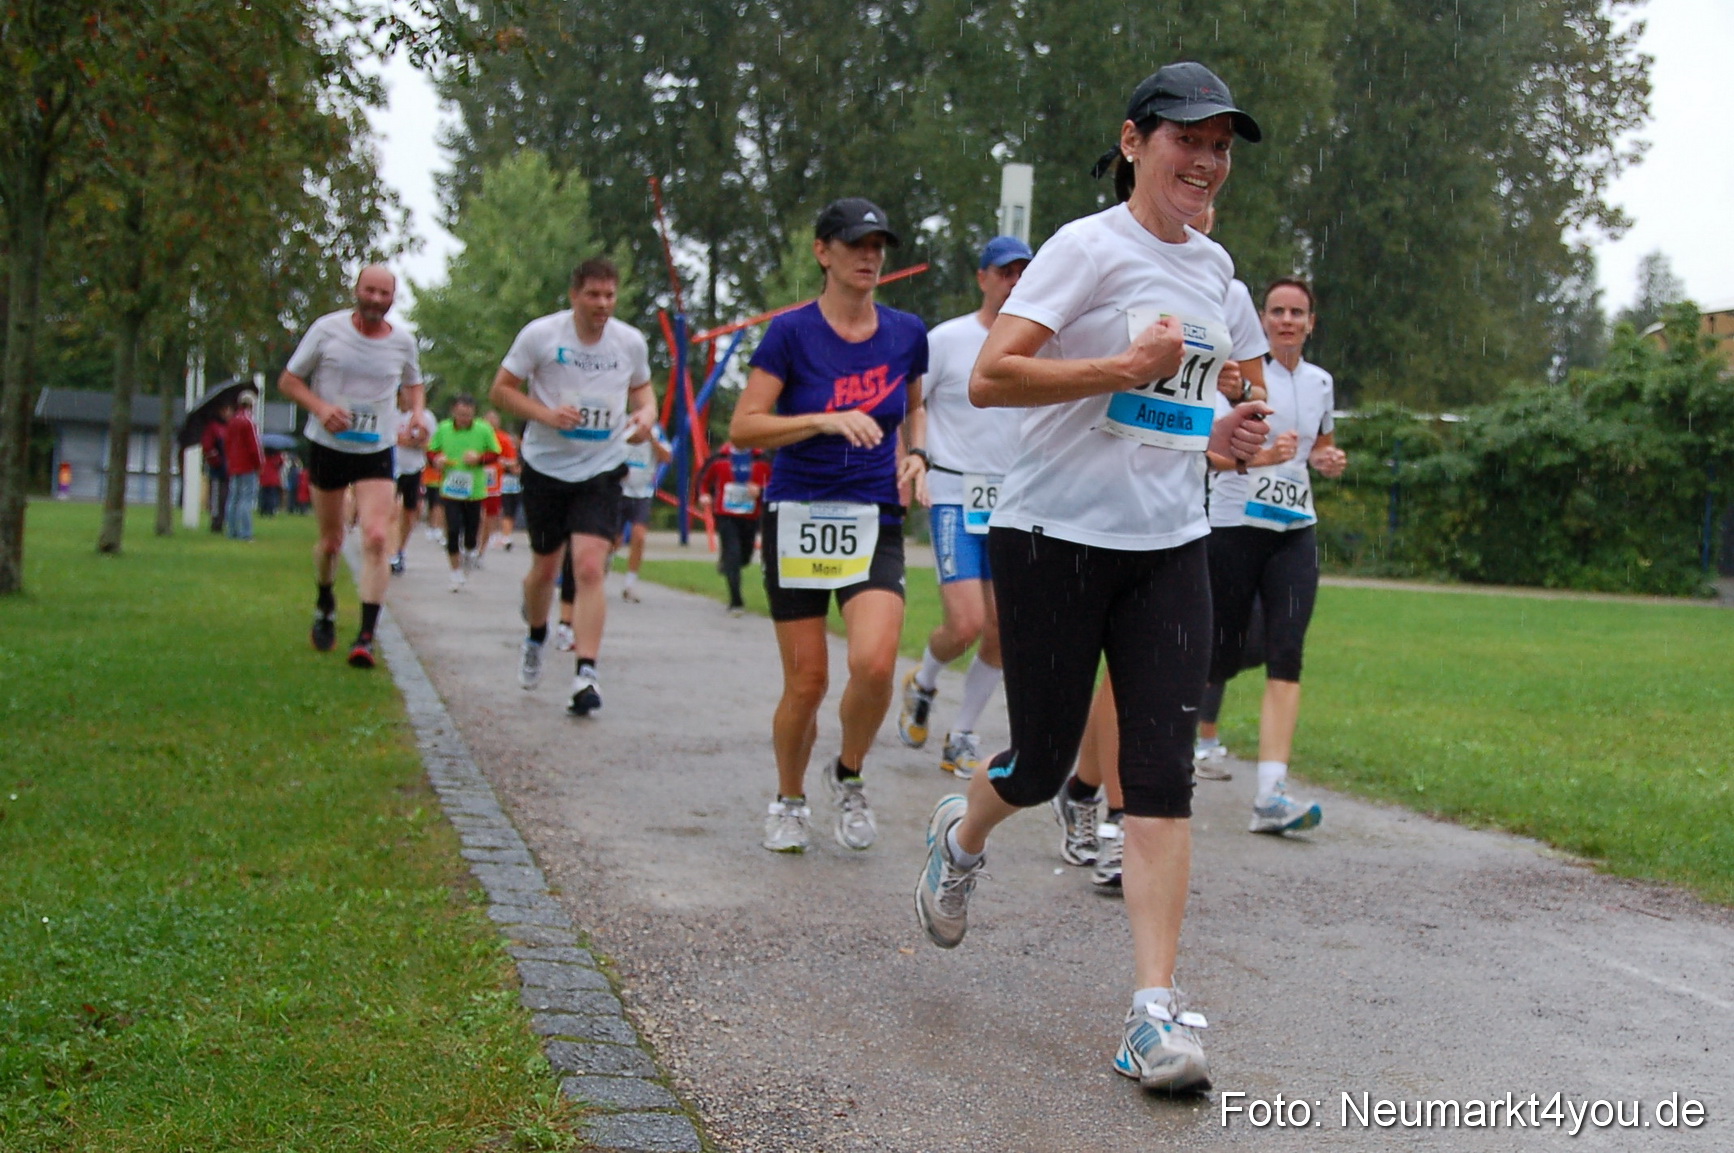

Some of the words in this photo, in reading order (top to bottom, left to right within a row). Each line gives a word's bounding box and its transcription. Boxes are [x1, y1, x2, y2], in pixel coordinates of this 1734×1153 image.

[834, 364, 890, 407] FAST
[971, 486, 998, 509] 26
[1255, 476, 1309, 509] 2594
[800, 523, 857, 555] 505
